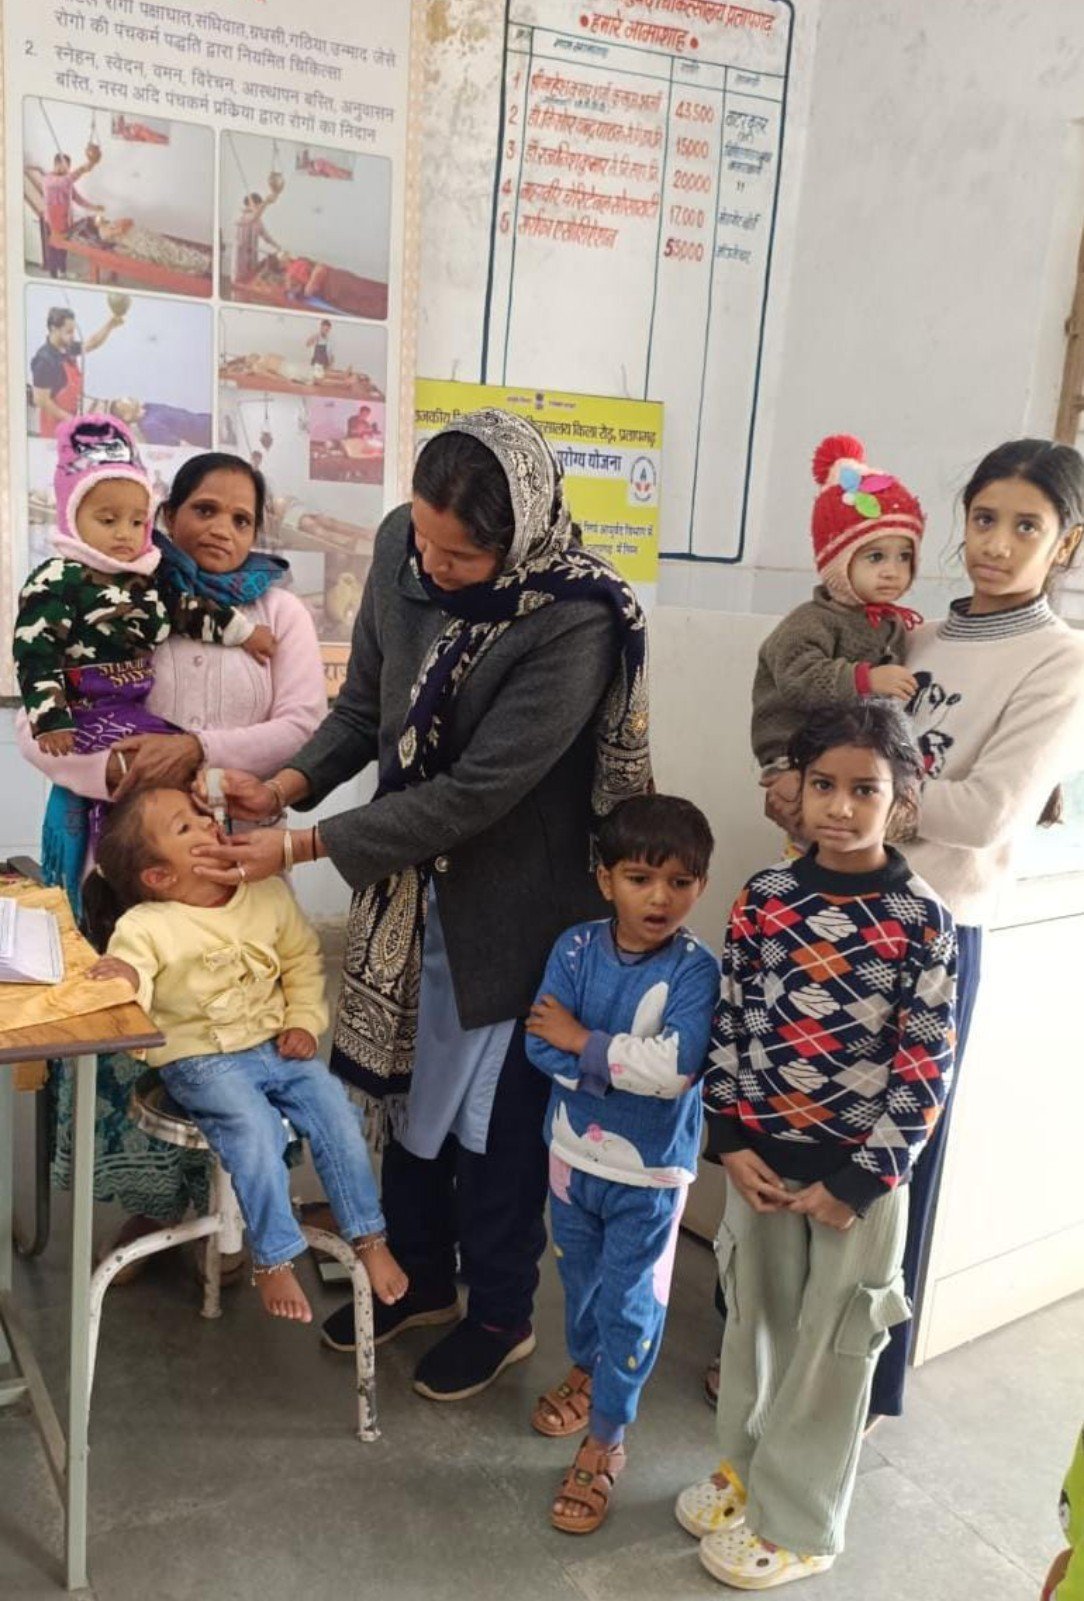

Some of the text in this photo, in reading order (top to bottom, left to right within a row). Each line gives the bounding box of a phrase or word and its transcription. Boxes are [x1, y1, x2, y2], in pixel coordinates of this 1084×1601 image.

[589, 11, 623, 38] हमारे
[90, 15, 110, 36] की
[163, 32, 202, 54] पद्धति
[206, 41, 233, 59] द्वारा
[237, 43, 286, 71] नियमित
[290, 53, 343, 81] चिकित्सा
[98, 79, 128, 99] नस्य
[259, 108, 285, 126] द्वारा
[319, 119, 336, 136] का
[339, 118, 377, 143] निदान
[508, 105, 518, 125] 2
[506, 139, 516, 160] 3
[502, 178, 512, 197] 4
[588, 448, 622, 471] योजना
